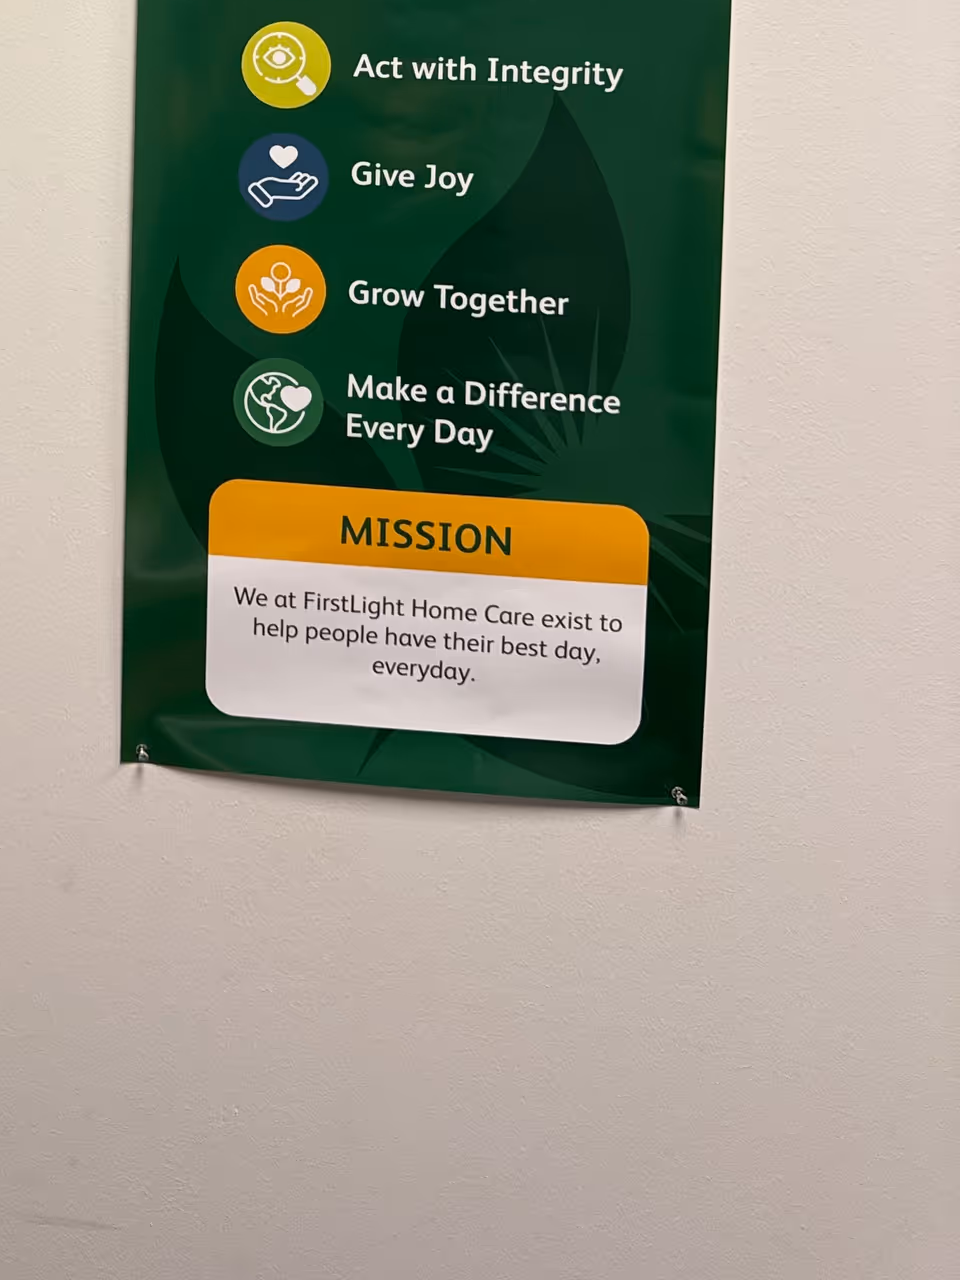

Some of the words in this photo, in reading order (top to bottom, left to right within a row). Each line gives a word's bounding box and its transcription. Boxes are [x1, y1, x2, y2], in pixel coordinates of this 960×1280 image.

[353, 53, 402, 78] Act
[411, 56, 476, 80] with
[487, 57, 623, 92] Integrity
[351, 161, 415, 187] Give
[424, 164, 474, 196] Joy
[348, 279, 424, 307] Grow
[433, 284, 569, 317] Together
[347, 373, 427, 402] Make
[436, 385, 454, 404] a
[465, 380, 620, 413] Difference
[346, 412, 424, 448] Every
[434, 418, 493, 453] Day
[341, 515, 511, 555] MISSION
[233, 586, 268, 606] We
[274, 592, 296, 608] at
[304, 591, 404, 619] FirstLight
[412, 598, 477, 621] Home
[484, 604, 534, 626] Care
[541, 611, 592, 630] exist
[599, 614, 622, 632] to
[253, 617, 298, 643] help
[305, 624, 377, 647] people
[385, 626, 436, 648] have
[443, 631, 494, 653] their
[501, 635, 547, 657] best
[554, 640, 600, 665] day,
[372, 660, 474, 685] everyday.
